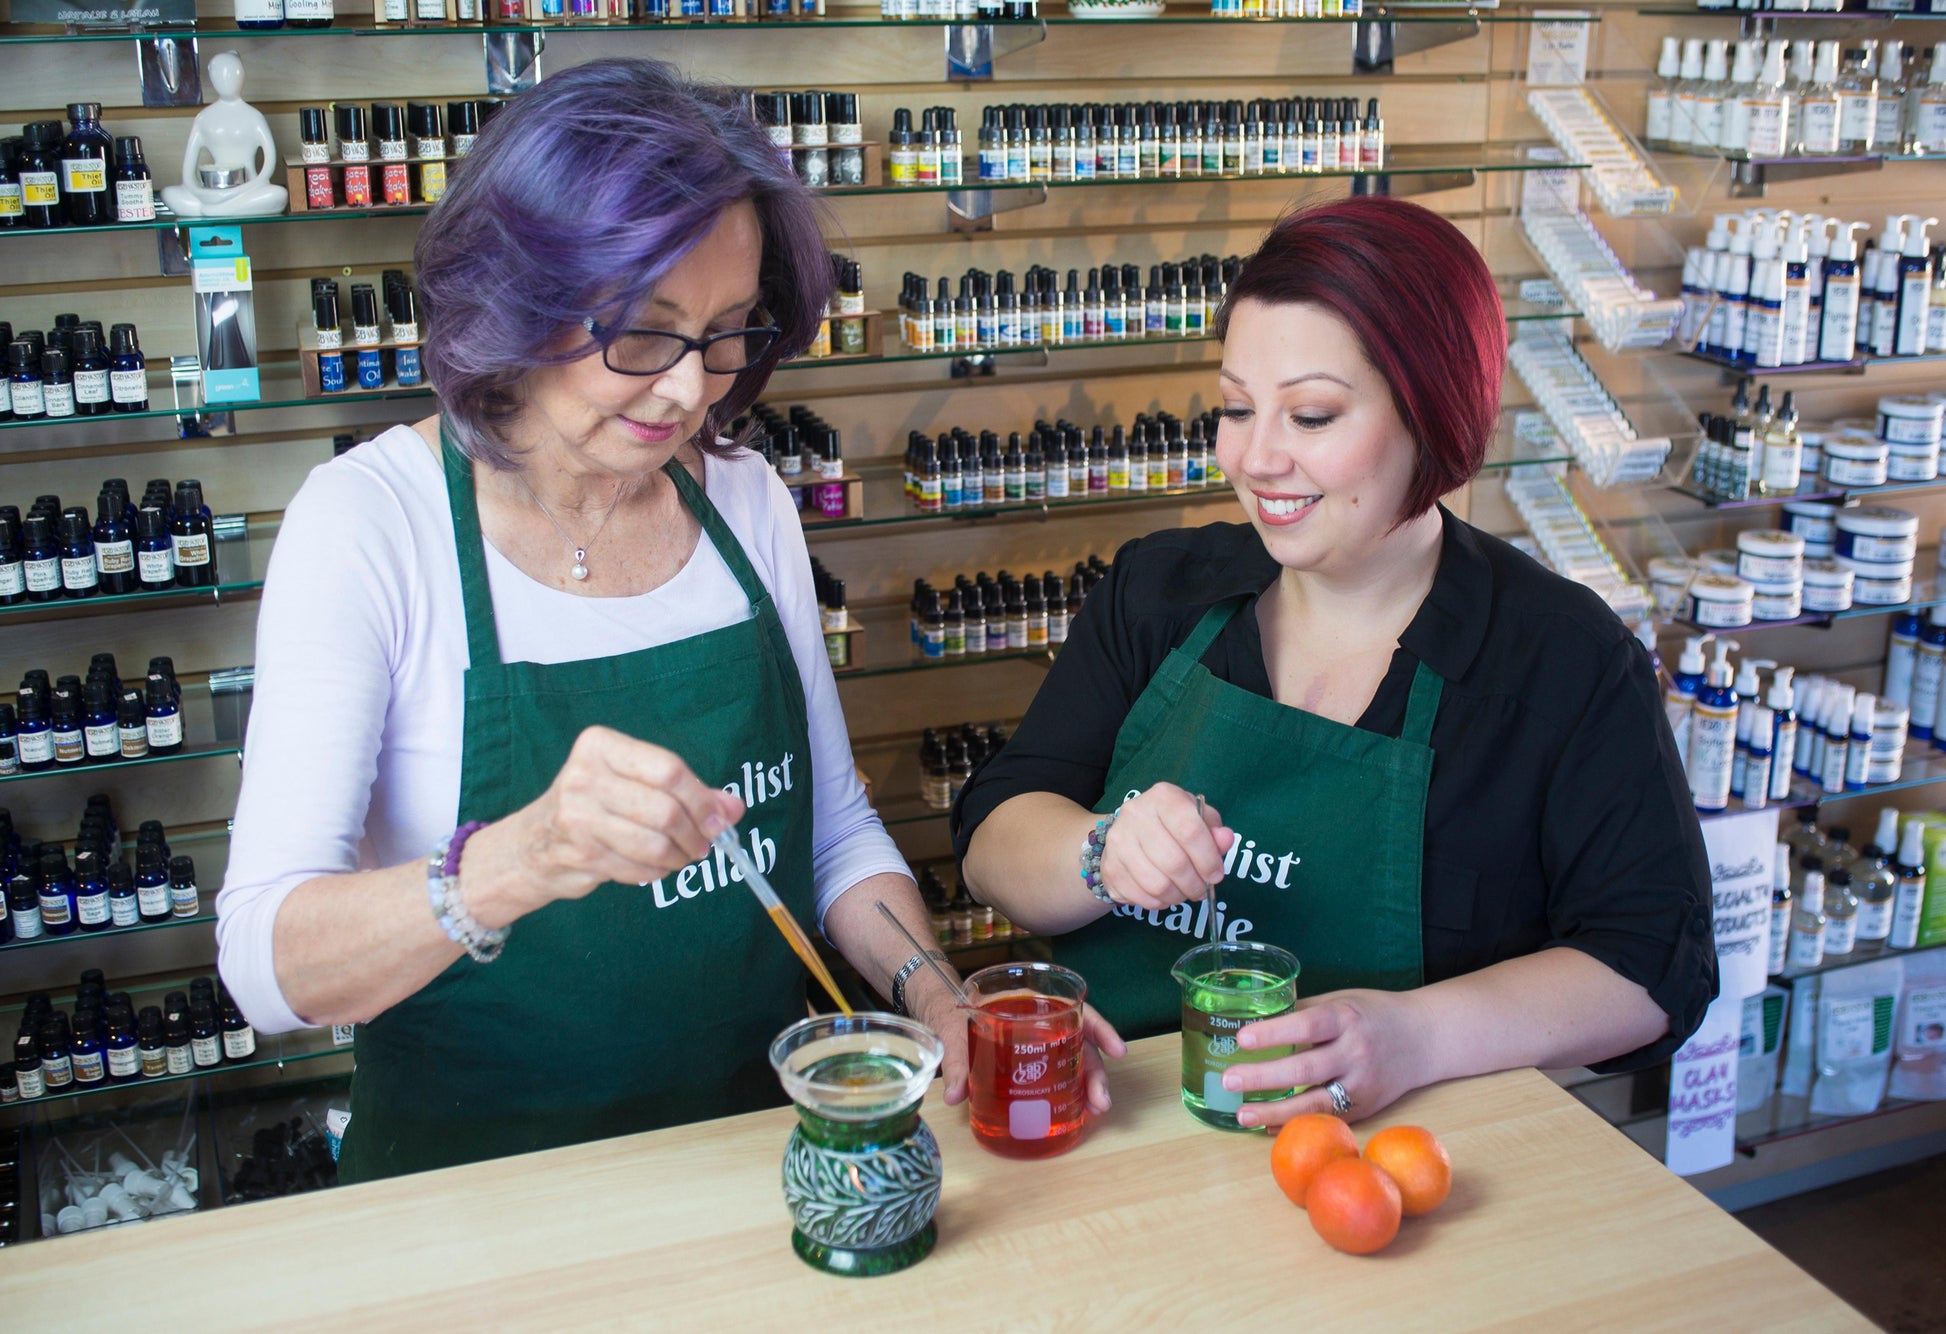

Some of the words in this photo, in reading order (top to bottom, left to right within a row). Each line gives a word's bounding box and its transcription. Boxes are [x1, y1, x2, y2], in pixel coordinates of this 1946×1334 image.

[118, 207, 155, 219] ESTER
[1713, 884, 1769, 910] ECIALTY
[1713, 908, 1766, 934] ODUCTS
[1209, 1016, 1241, 1029] 250ml
[1014, 1042, 1046, 1055] 250ml
[1018, 1062, 1041, 1074] Lab
[1057, 1059, 1067, 1069] 50
[1009, 1088, 1051, 1097] BOROSILICATE
[1053, 1081, 1067, 1092] 100
